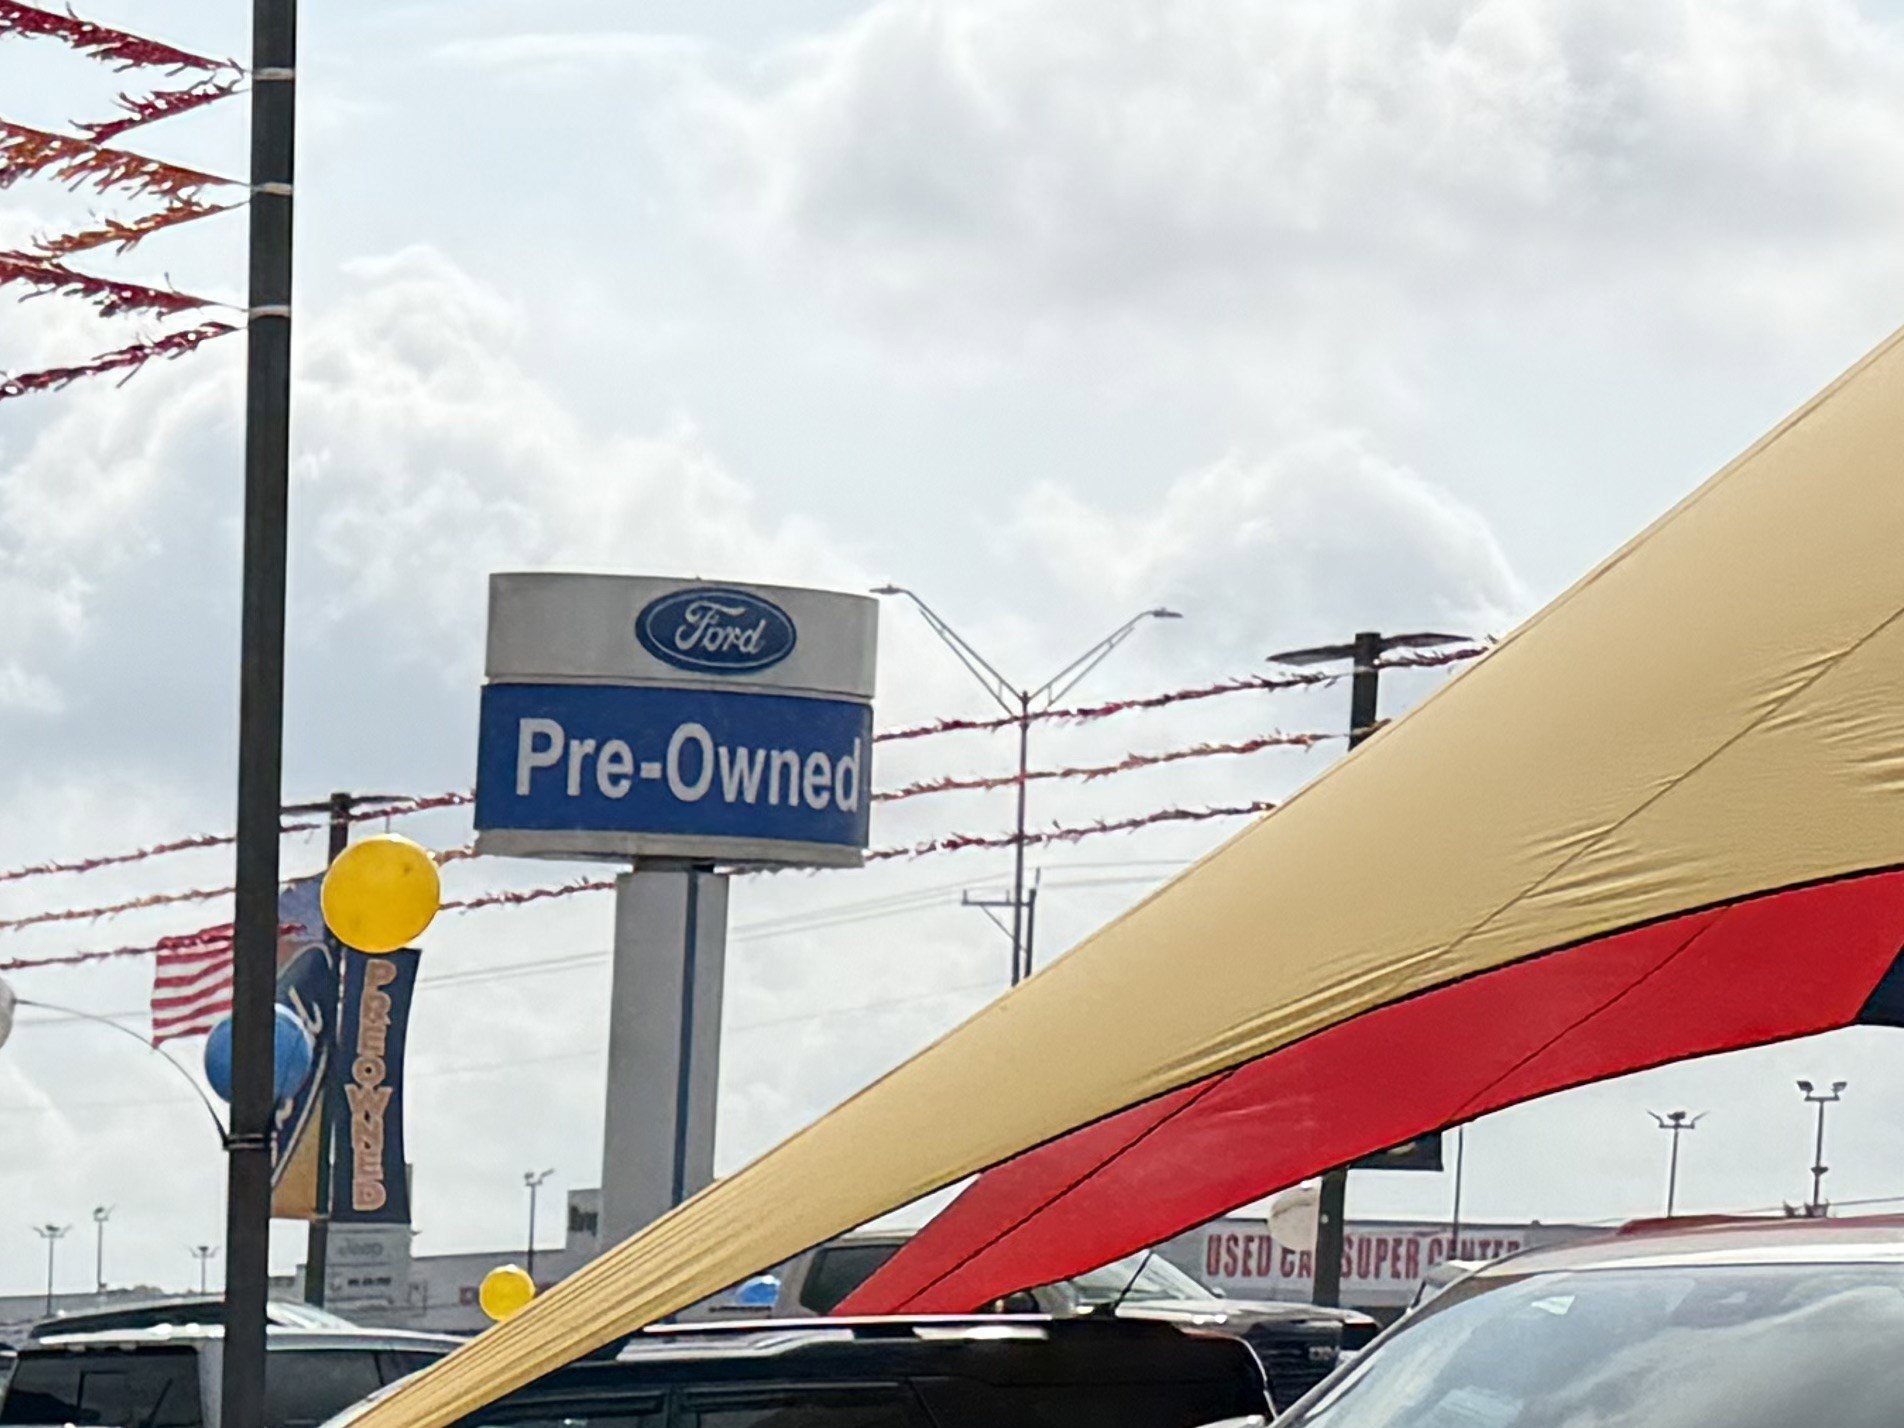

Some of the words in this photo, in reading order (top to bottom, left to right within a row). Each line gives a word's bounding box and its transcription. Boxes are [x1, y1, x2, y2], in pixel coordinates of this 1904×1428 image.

[674, 600, 768, 655] Ford
[515, 717, 861, 813] Pre-Owned
[1206, 1233, 1272, 1278] USED
[1340, 1233, 1420, 1280] SUPER
[1427, 1237, 1521, 1266] CENT
